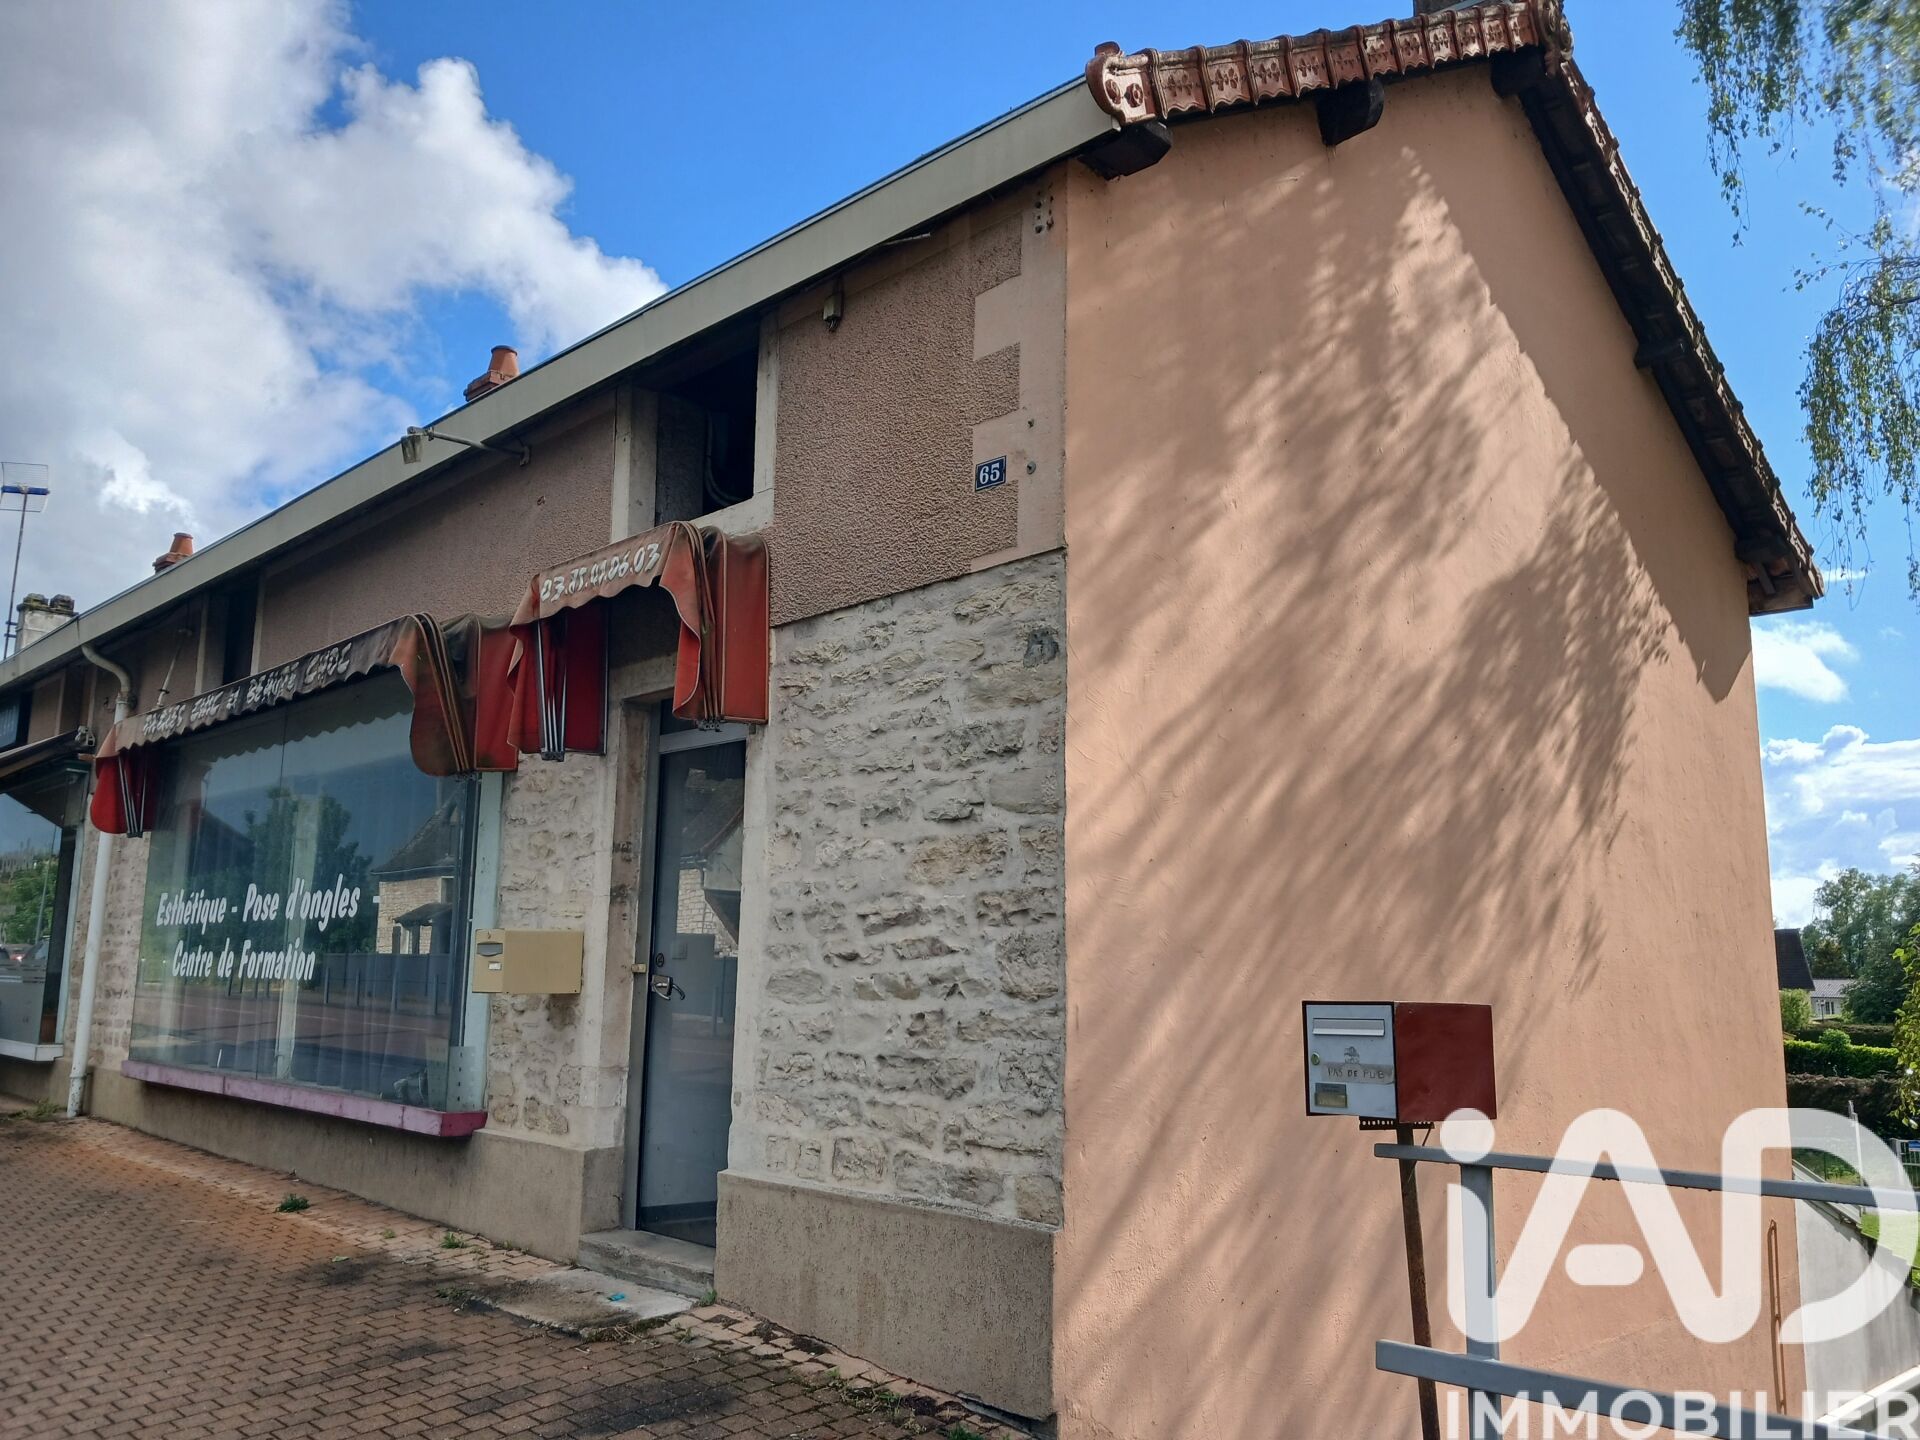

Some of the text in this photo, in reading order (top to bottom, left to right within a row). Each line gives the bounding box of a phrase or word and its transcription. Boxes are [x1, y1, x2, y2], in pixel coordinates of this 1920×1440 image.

[979, 462, 1001, 485] 65
[156, 888, 227, 935] Esthétique
[242, 883, 280, 923] Pose
[285, 873, 361, 932] d'ongles
[172, 937, 316, 981] Centre de Formation
[1347, 1069, 1358, 1078] DE
